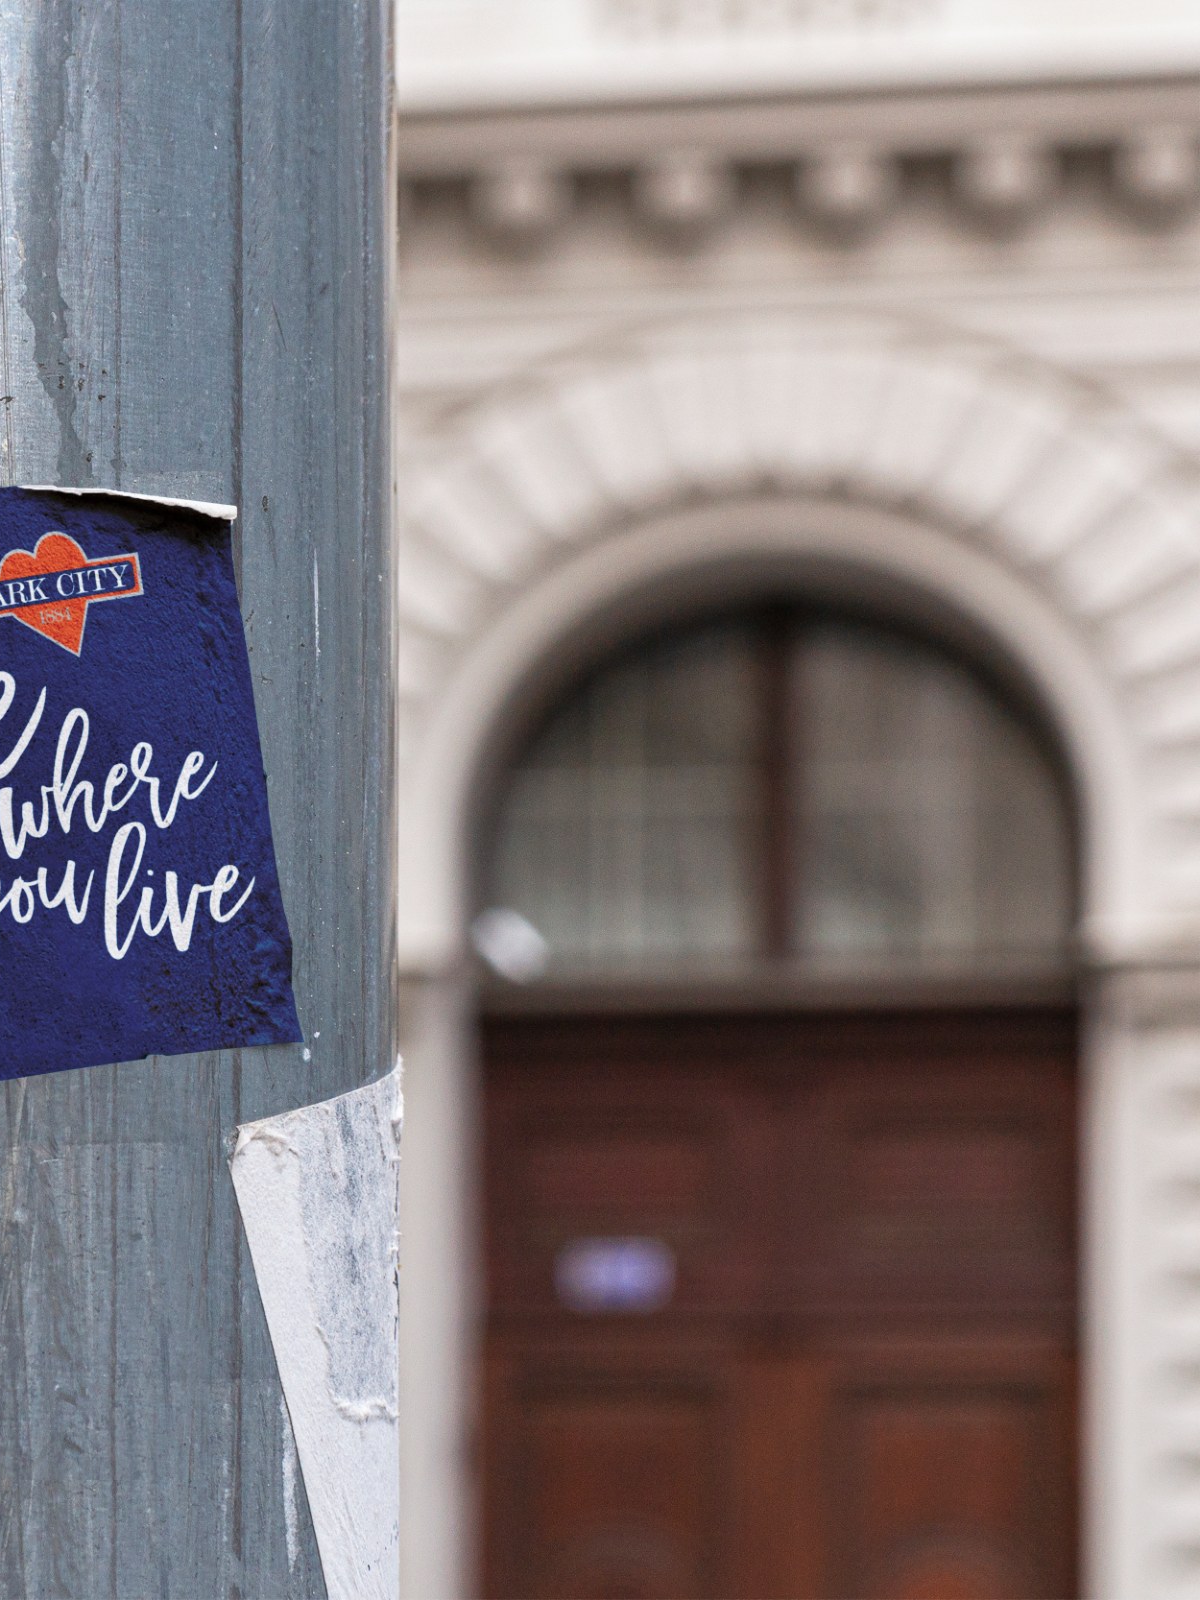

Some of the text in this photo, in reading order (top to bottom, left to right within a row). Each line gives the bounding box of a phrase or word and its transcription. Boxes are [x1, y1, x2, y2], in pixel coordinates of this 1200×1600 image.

[56, 563, 129, 597] CITY
[38, 606, 73, 625] 1884
[104, 822, 256, 960] live
